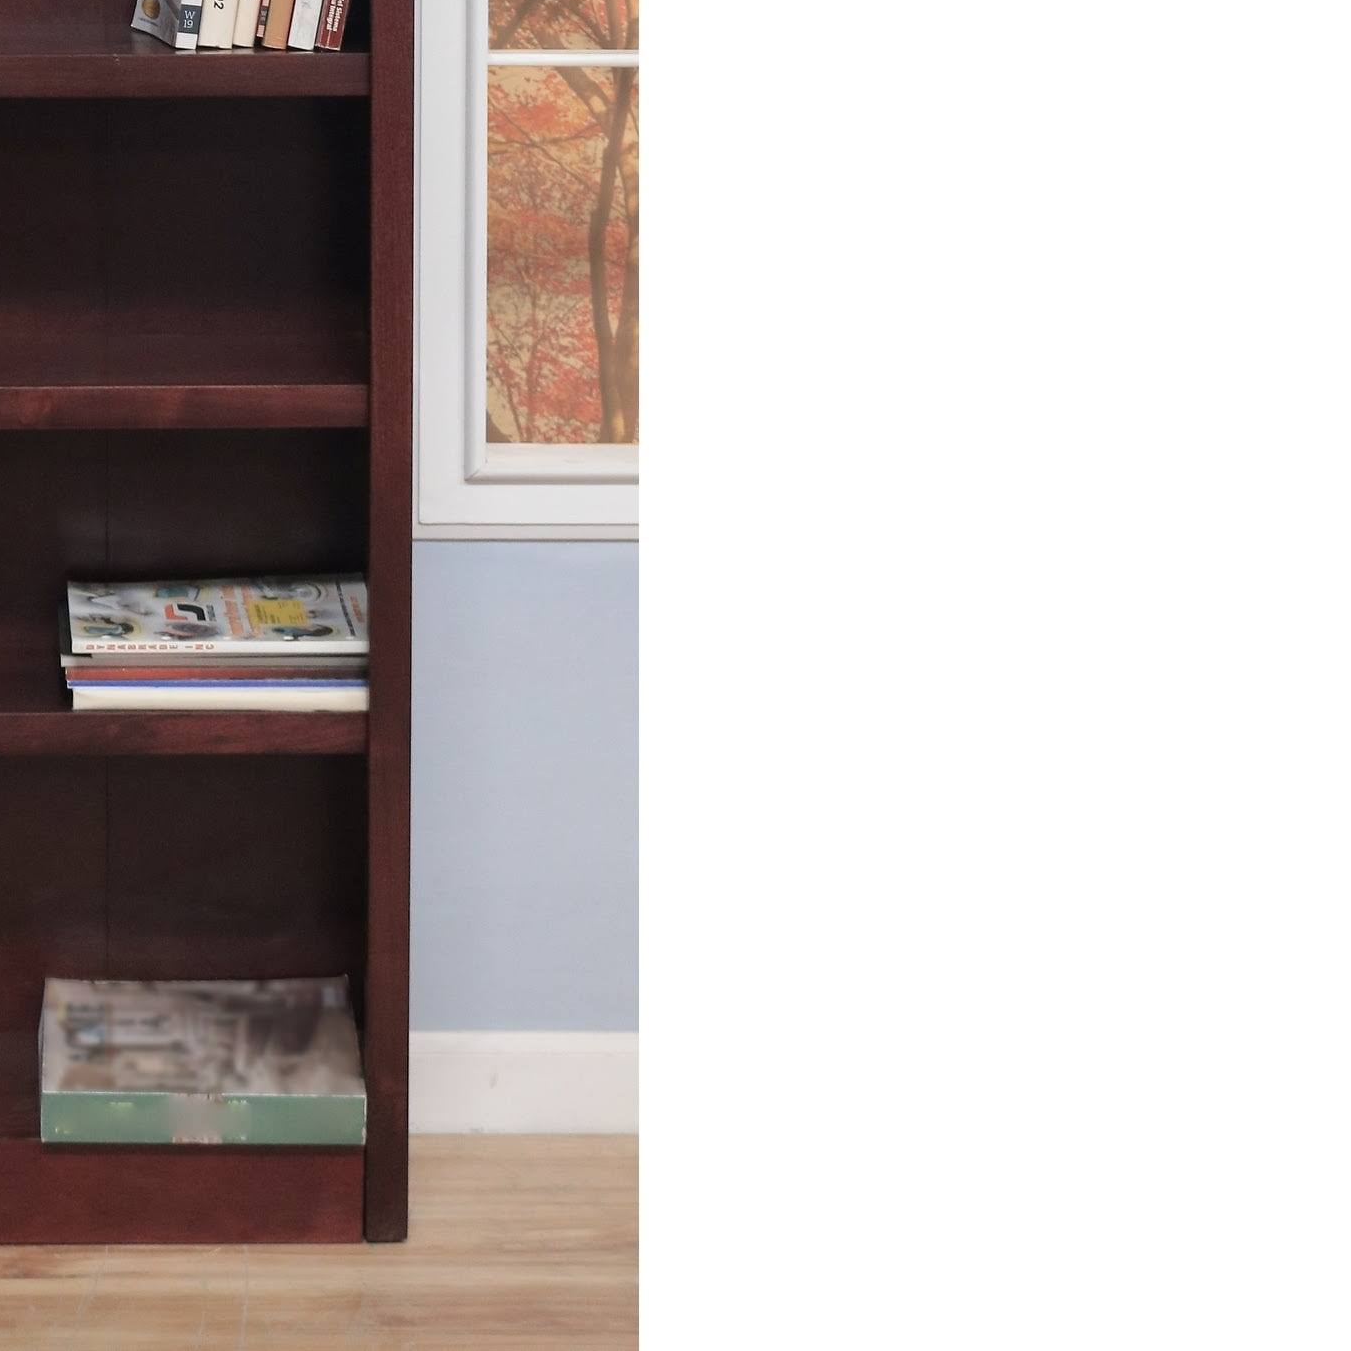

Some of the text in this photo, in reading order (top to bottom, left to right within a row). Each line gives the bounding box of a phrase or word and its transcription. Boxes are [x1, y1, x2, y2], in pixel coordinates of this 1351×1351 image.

[185, 11, 195, 19] W
[327, 5, 335, 31] Integral
[333, 7, 343, 31] Sistema
[183, 19, 194, 29] 19
